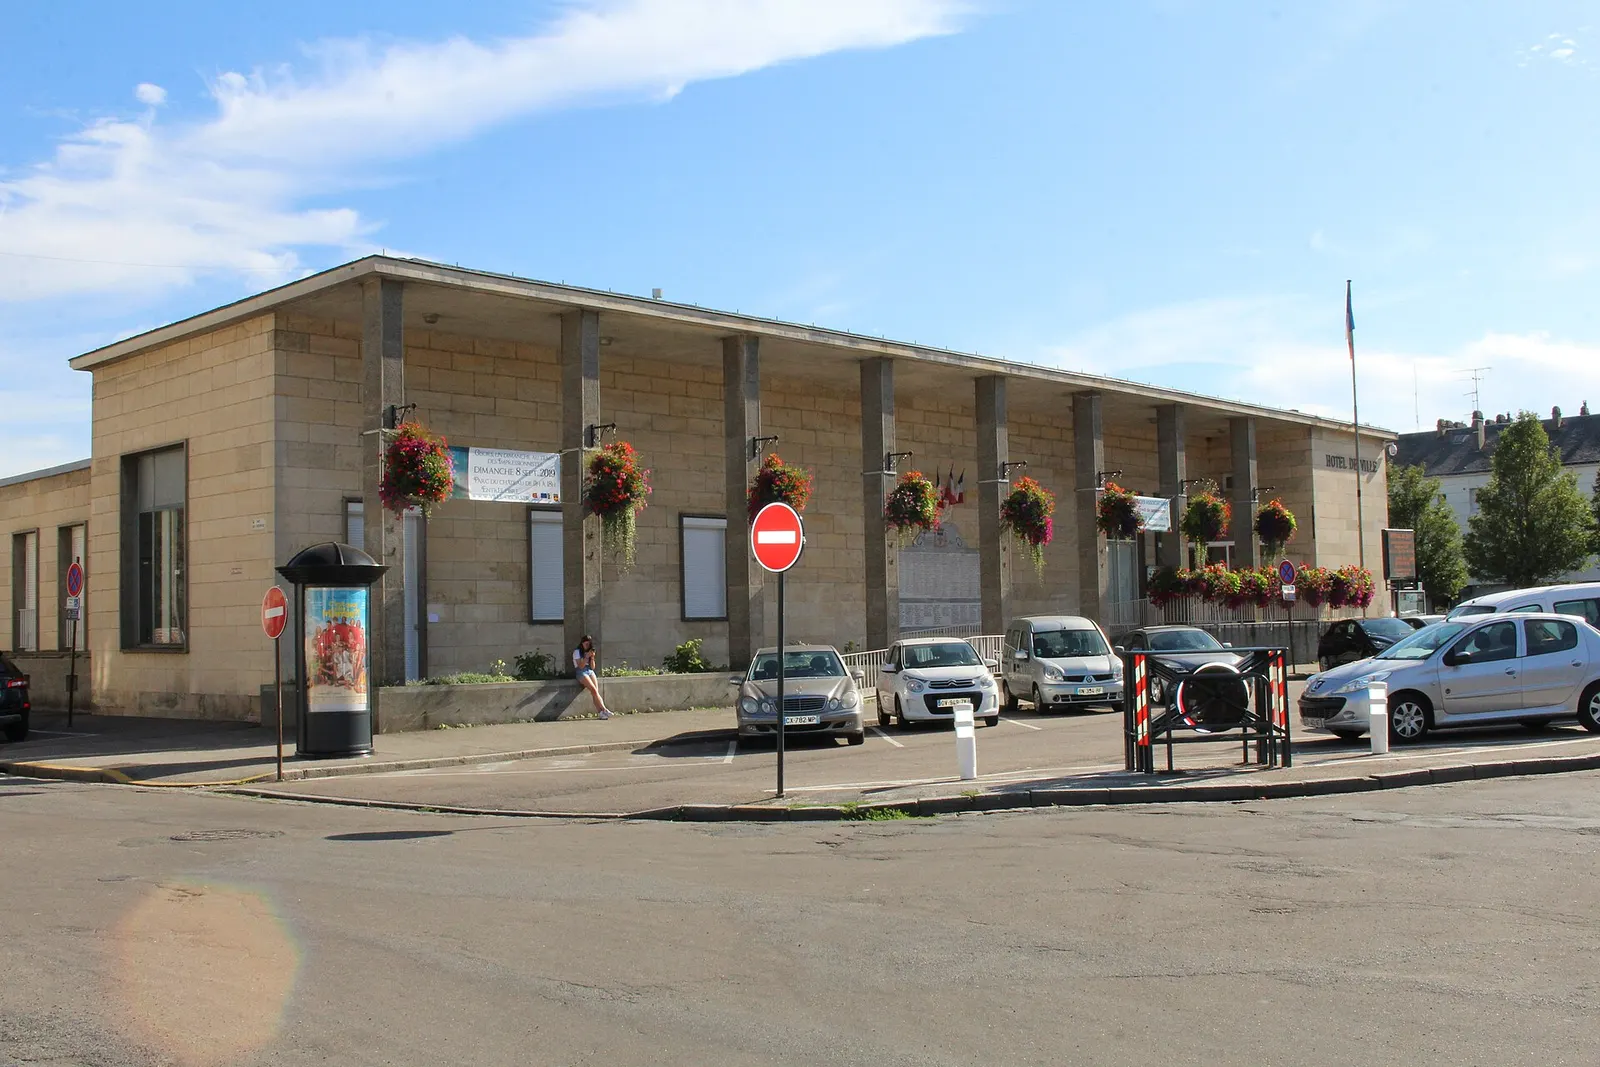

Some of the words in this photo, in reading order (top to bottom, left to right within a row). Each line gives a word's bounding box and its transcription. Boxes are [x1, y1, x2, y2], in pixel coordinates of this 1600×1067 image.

[1349, 457, 1358, 471] DE
[1360, 459, 1378, 473] VILLE
[473, 466, 514, 476] DIMANCHE
[515, 467, 521, 476] 8
[540, 468, 556, 478] 2019
[473, 477, 490, 485] PARC
